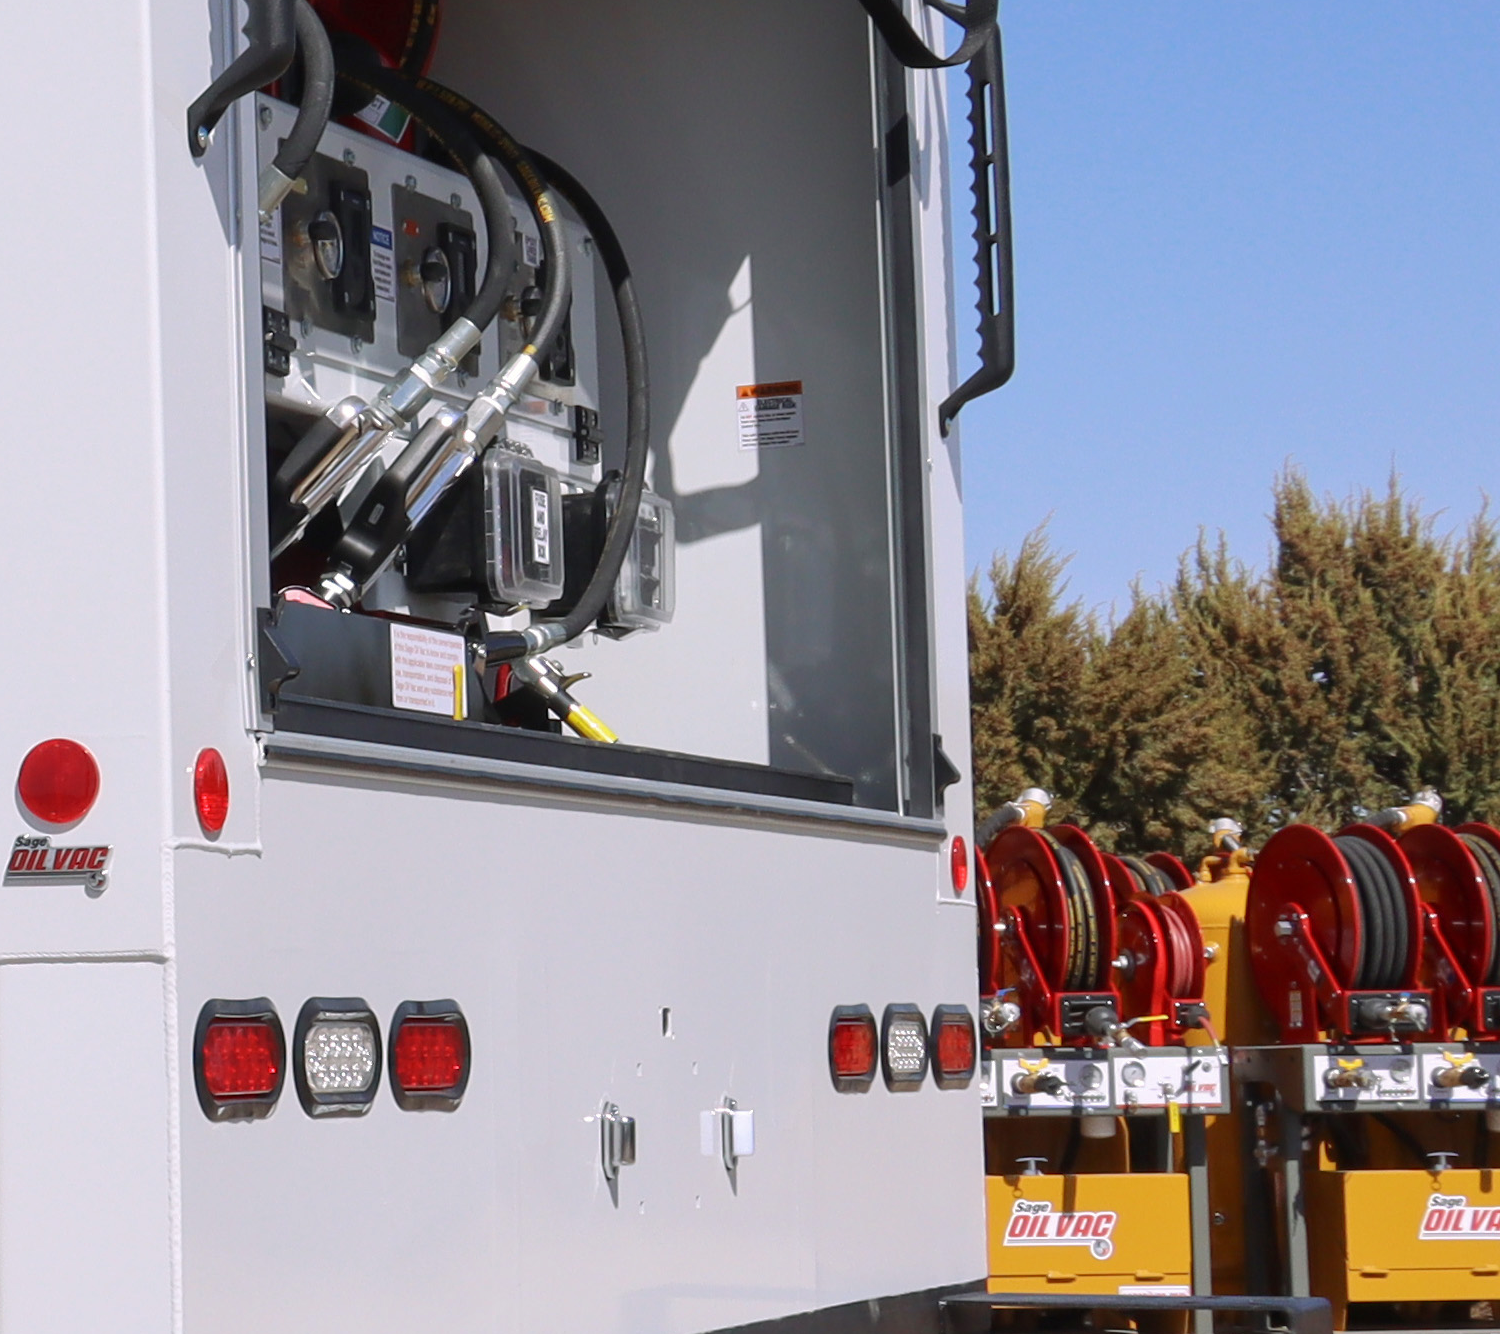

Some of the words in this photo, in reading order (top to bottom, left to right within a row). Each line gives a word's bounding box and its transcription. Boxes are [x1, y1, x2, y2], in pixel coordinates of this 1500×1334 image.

[15, 835, 48, 848] Sage
[9, 849, 49, 871] OIL
[53, 847, 109, 870] VAC
[1015, 1202, 1049, 1214] Sage
[1430, 1196, 1464, 1208] Sage
[1008, 1214, 1050, 1238] OIL
[1056, 1214, 1114, 1238] VAC
[1424, 1209, 1466, 1231] OIL
[1470, 1209, 1500, 1231] VA
